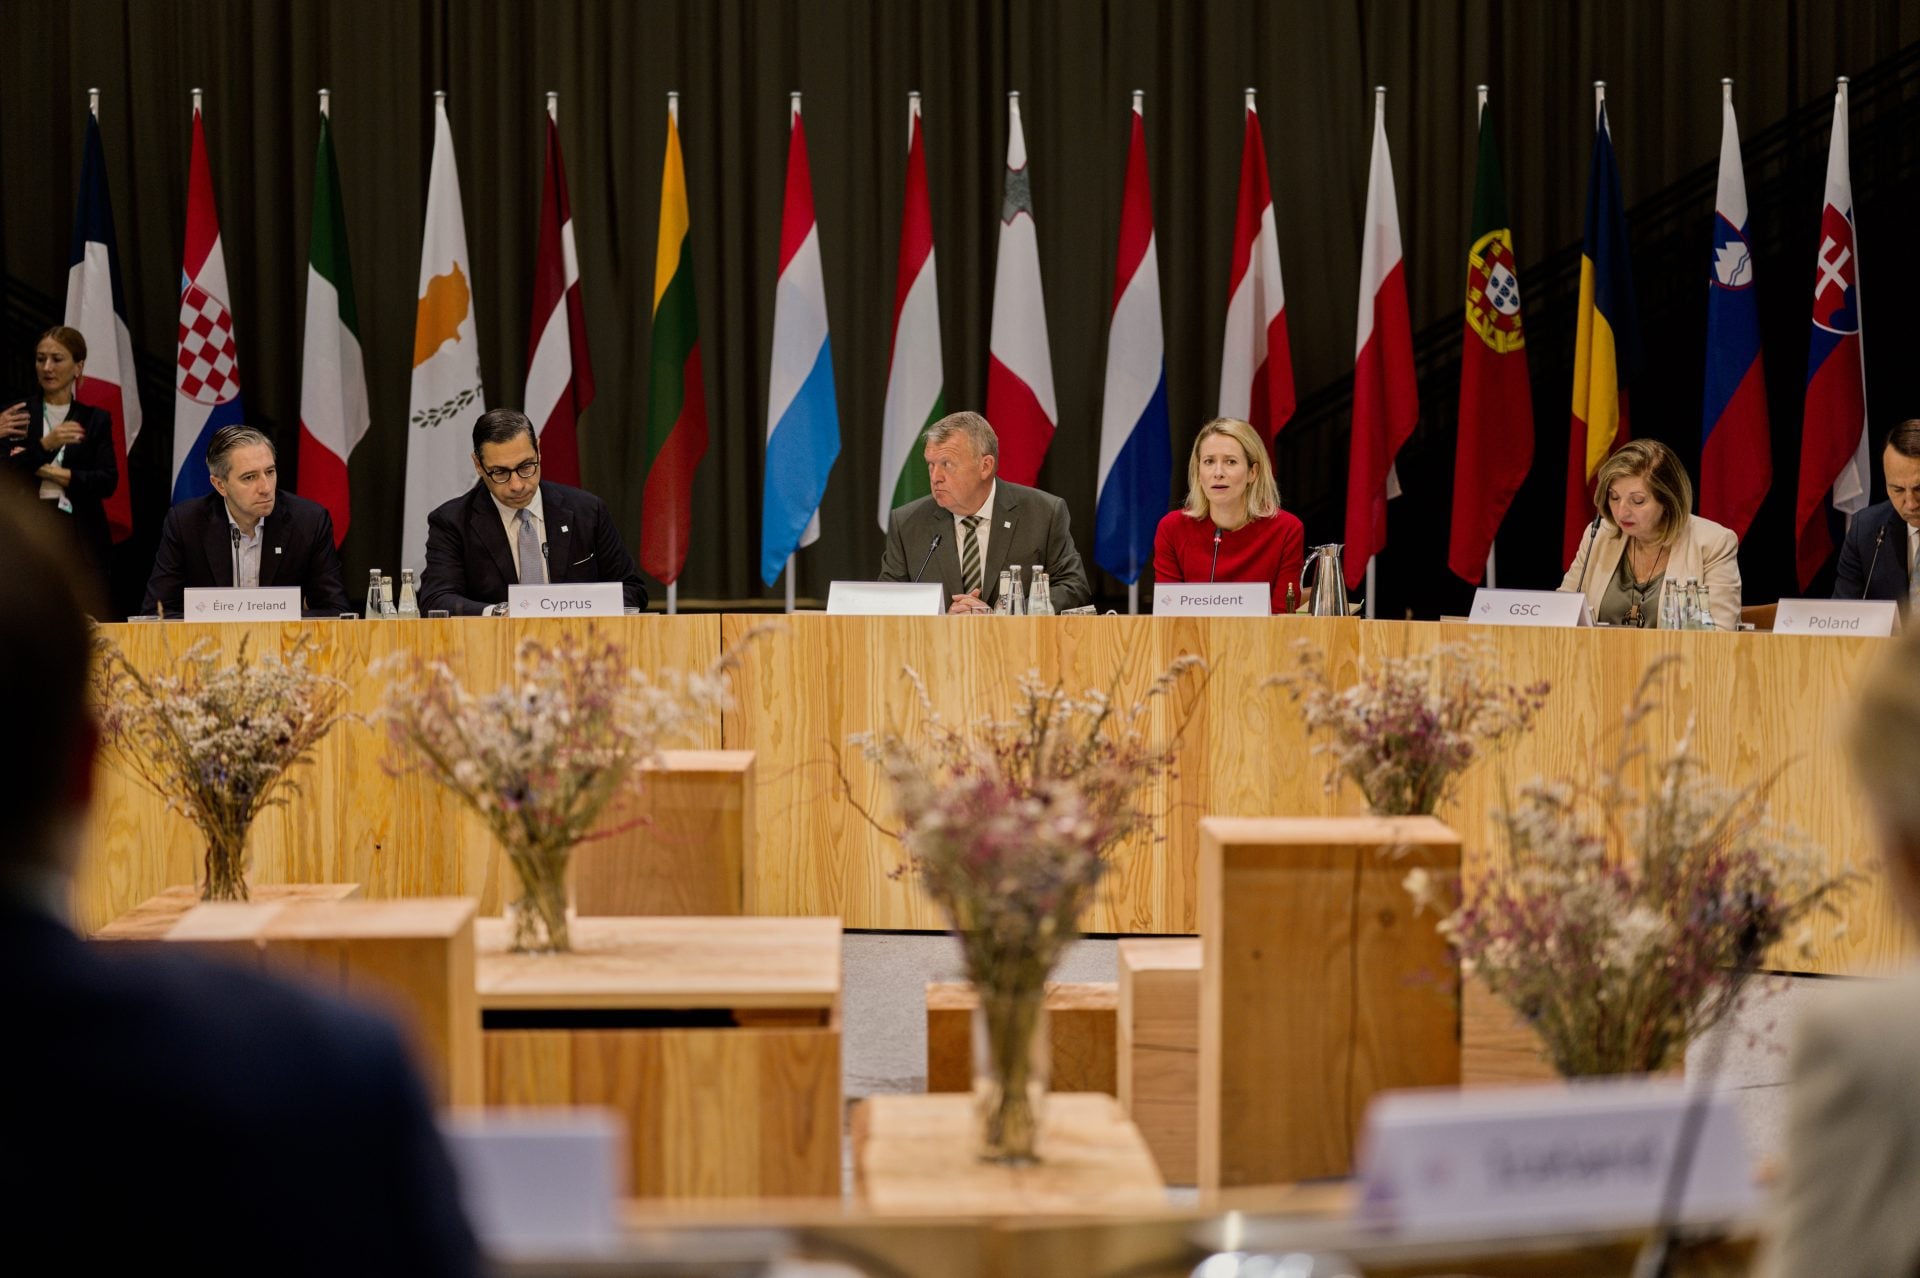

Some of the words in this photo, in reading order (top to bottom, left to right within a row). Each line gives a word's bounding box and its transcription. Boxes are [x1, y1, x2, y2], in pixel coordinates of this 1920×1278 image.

[212, 599, 235, 611] Éire
[237, 601, 243, 613] /
[246, 600, 286, 611] Ireland
[540, 597, 592, 612] Cyprus
[1179, 594, 1244, 606] President
[1509, 603, 1541, 616] GSC
[1808, 616, 1860, 630] Poland
